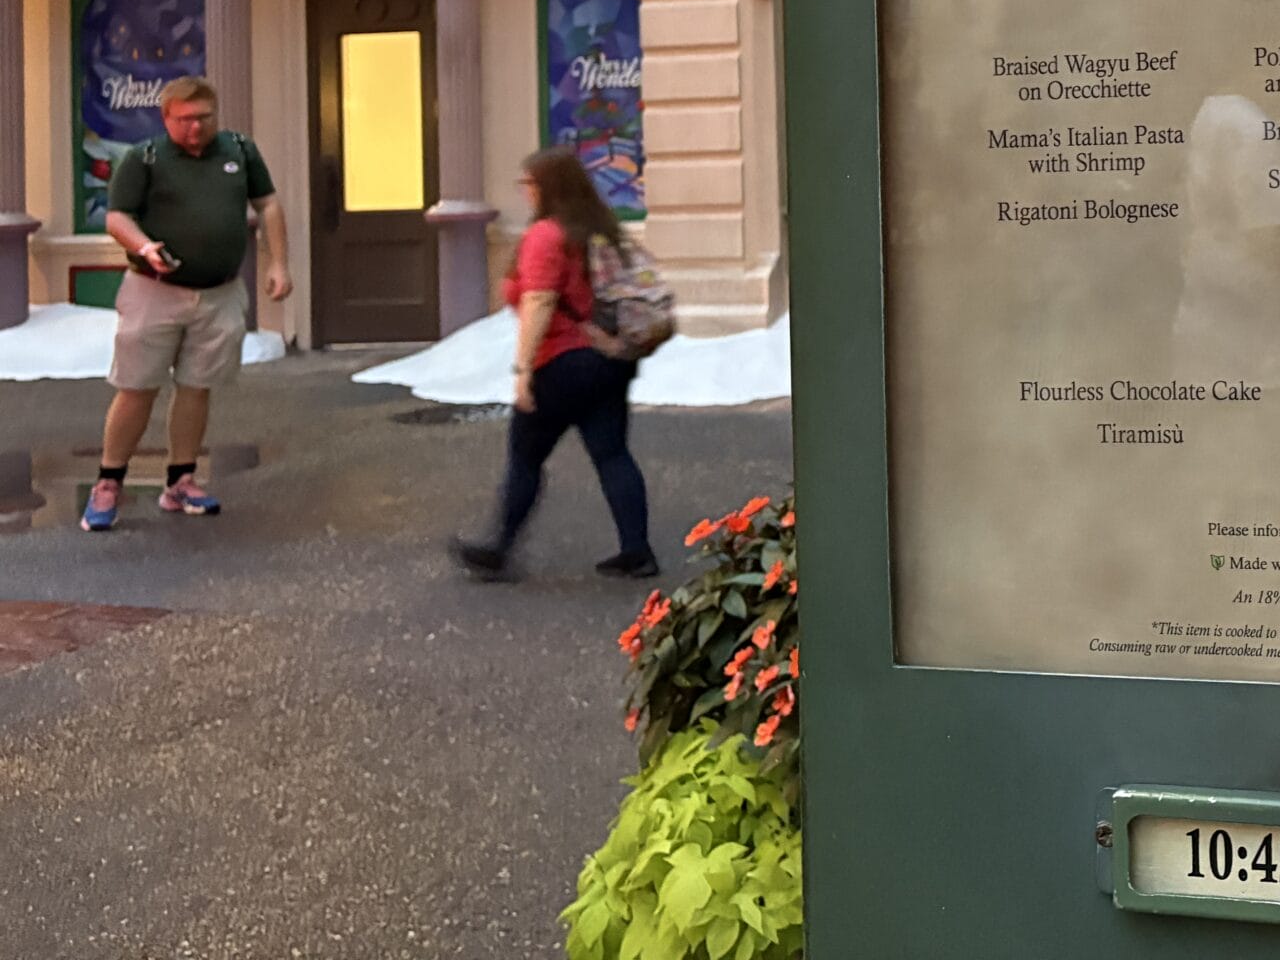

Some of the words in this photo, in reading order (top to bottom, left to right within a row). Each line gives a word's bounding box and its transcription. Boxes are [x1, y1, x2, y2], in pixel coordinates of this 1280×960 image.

[993, 55, 1059, 76] Braised
[1064, 54, 1130, 78] Wagyu
[1135, 50, 1178, 71] Beef
[1018, 87, 1042, 101] on
[1047, 79, 1151, 100] Orecchiette
[988, 128, 1061, 149] Mama's
[1067, 126, 1129, 147] Italian
[1134, 125, 1185, 145] Pasta
[1028, 153, 1070, 173] with
[1076, 151, 1145, 176] Shrimp
[998, 199, 1078, 226] Rigatoni
[1083, 198, 1179, 223] Bolognese
[1019, 381, 1104, 401] Flourless
[1110, 380, 1206, 401] Chocolate
[1212, 380, 1261, 401] Cake
[1097, 423, 1184, 444] Tiramisù
[1208, 522, 1249, 537] Please
[1229, 556, 1267, 570] Made
[1232, 590, 1252, 604] An
[1185, 624, 1211, 637] item
[1213, 624, 1223, 637] is
[1225, 624, 1264, 639] cooked
[1265, 628, 1277, 639] to
[1089, 638, 1152, 656] Consuming
[1155, 644, 1177, 654] raw
[1178, 645, 1192, 654] or
[1194, 641, 1264, 657] undercooked
